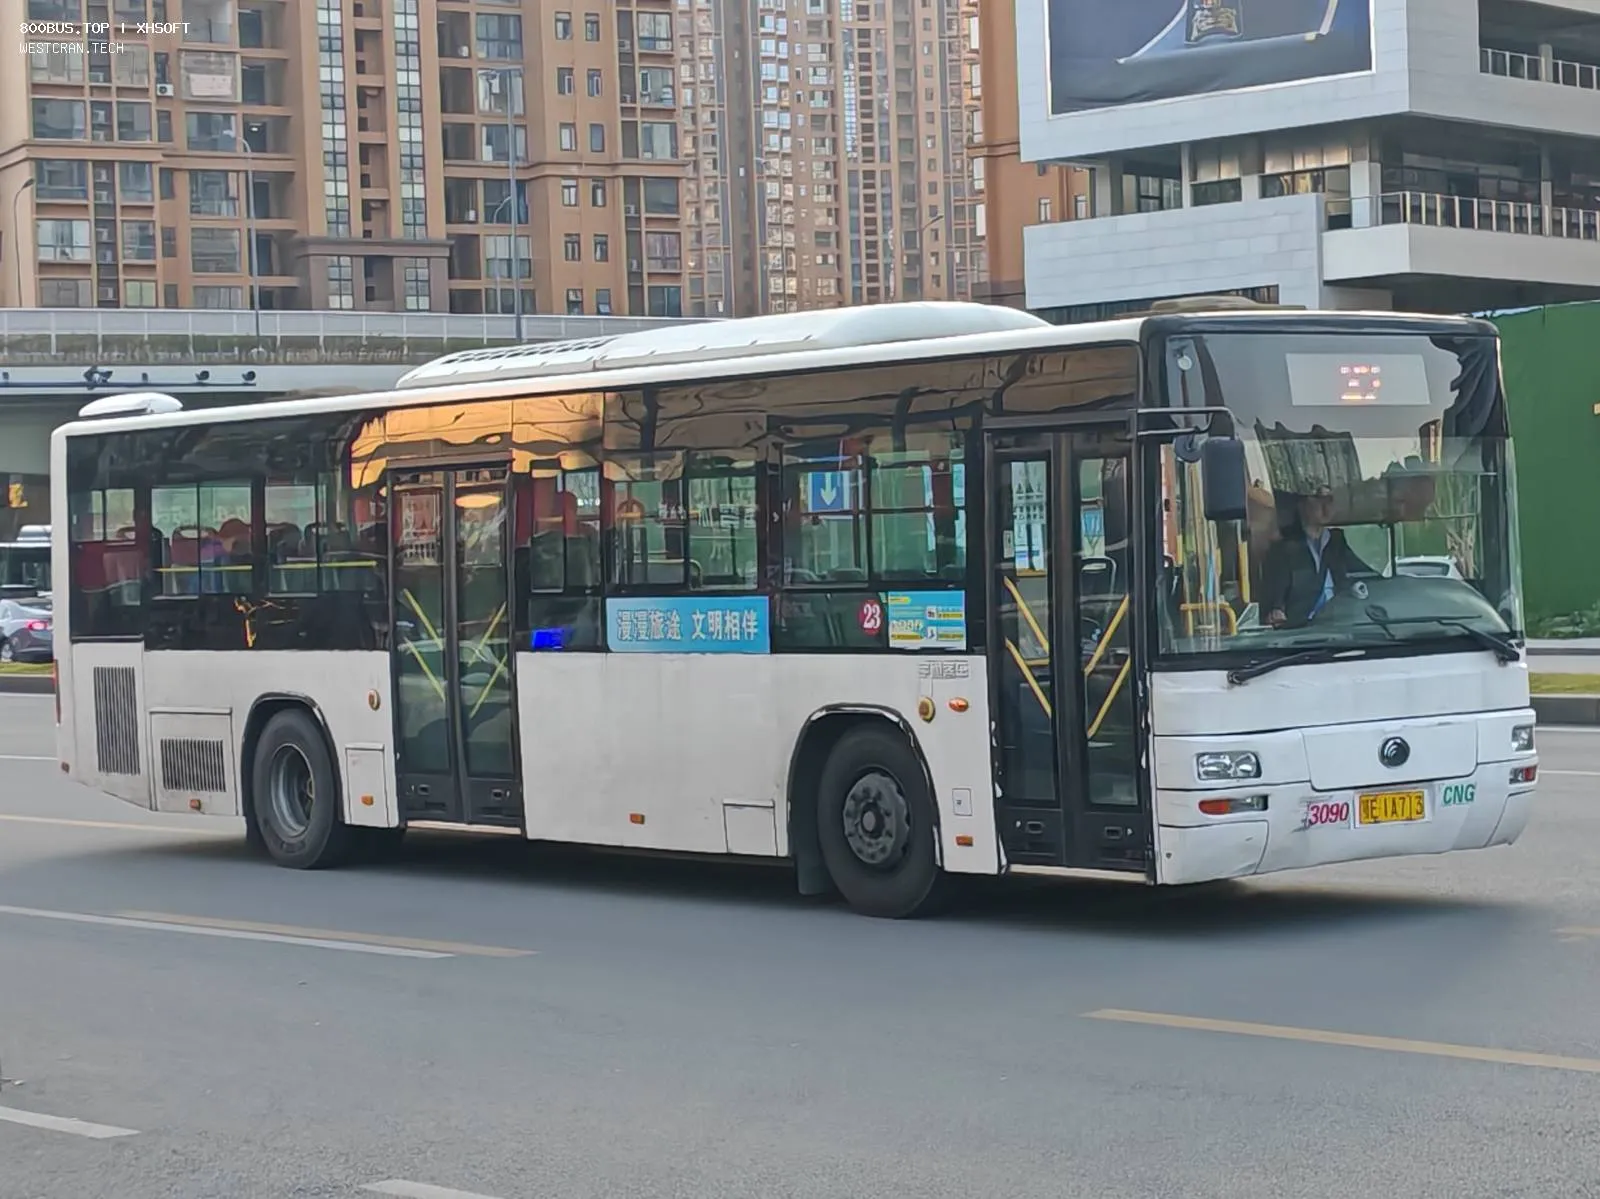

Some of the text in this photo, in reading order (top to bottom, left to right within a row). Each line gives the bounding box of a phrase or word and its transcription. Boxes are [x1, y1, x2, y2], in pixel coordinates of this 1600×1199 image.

[690, 609, 759, 641] 文明相伴
[863, 603, 881, 629] 23
[1442, 783, 1476, 805] CNG
[1310, 802, 1350, 826] 3090
